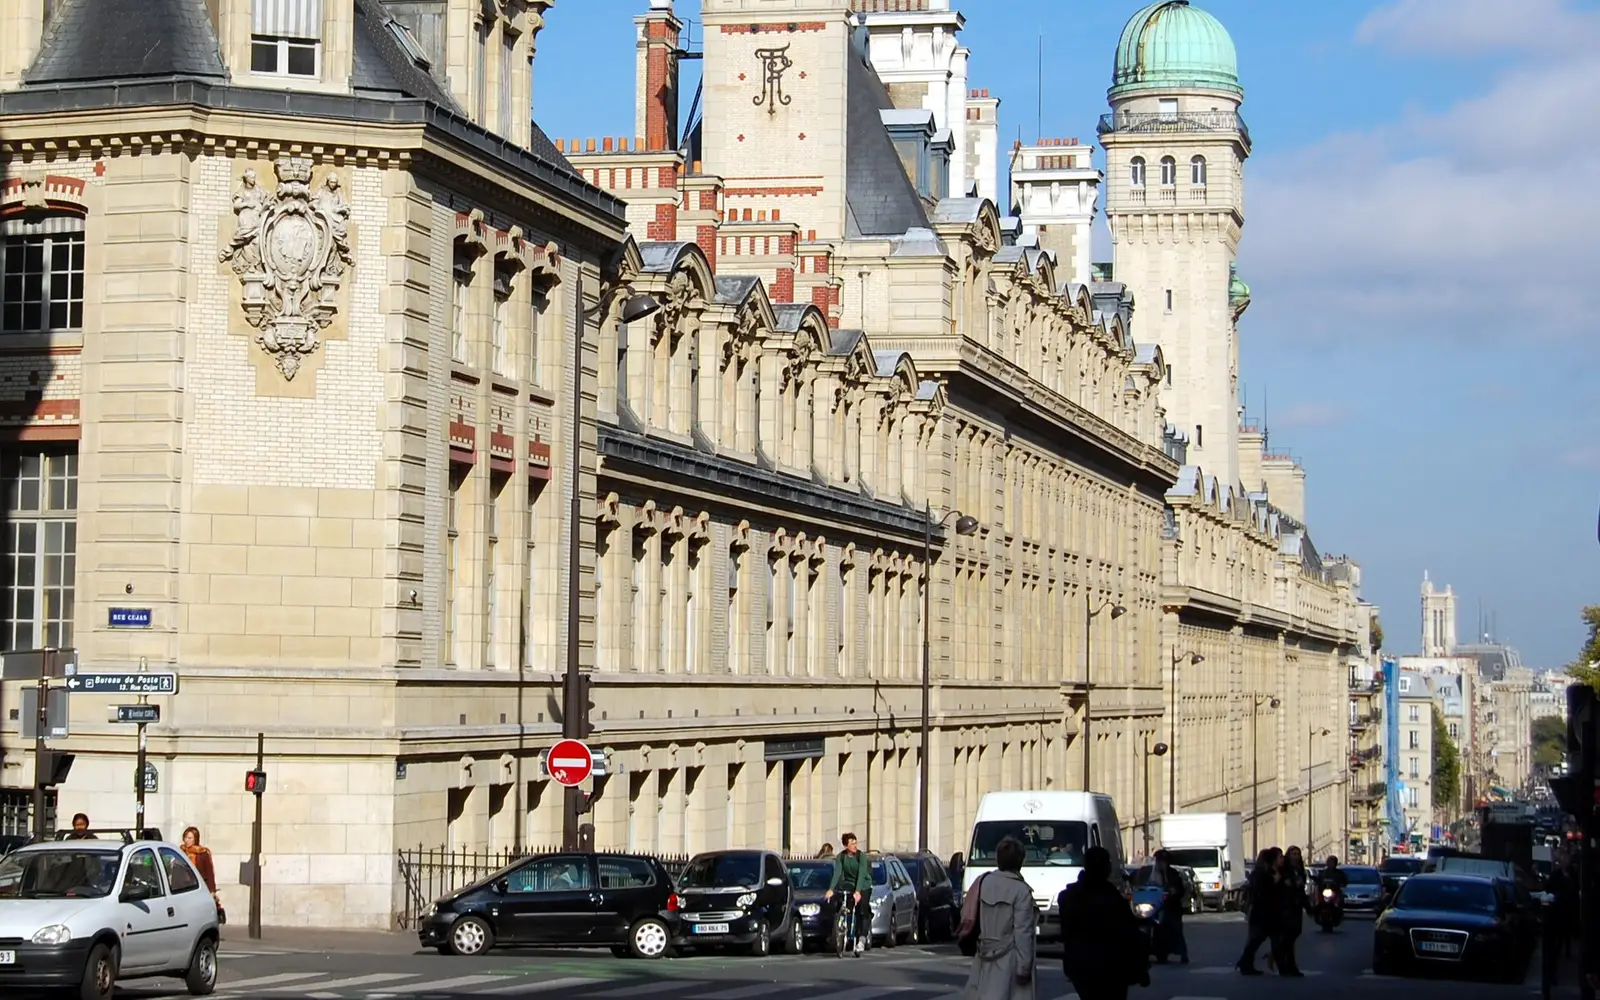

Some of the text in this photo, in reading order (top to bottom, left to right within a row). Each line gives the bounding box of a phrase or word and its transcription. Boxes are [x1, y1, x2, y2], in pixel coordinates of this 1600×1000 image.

[95, 676, 159, 684] Bureau de Poste
